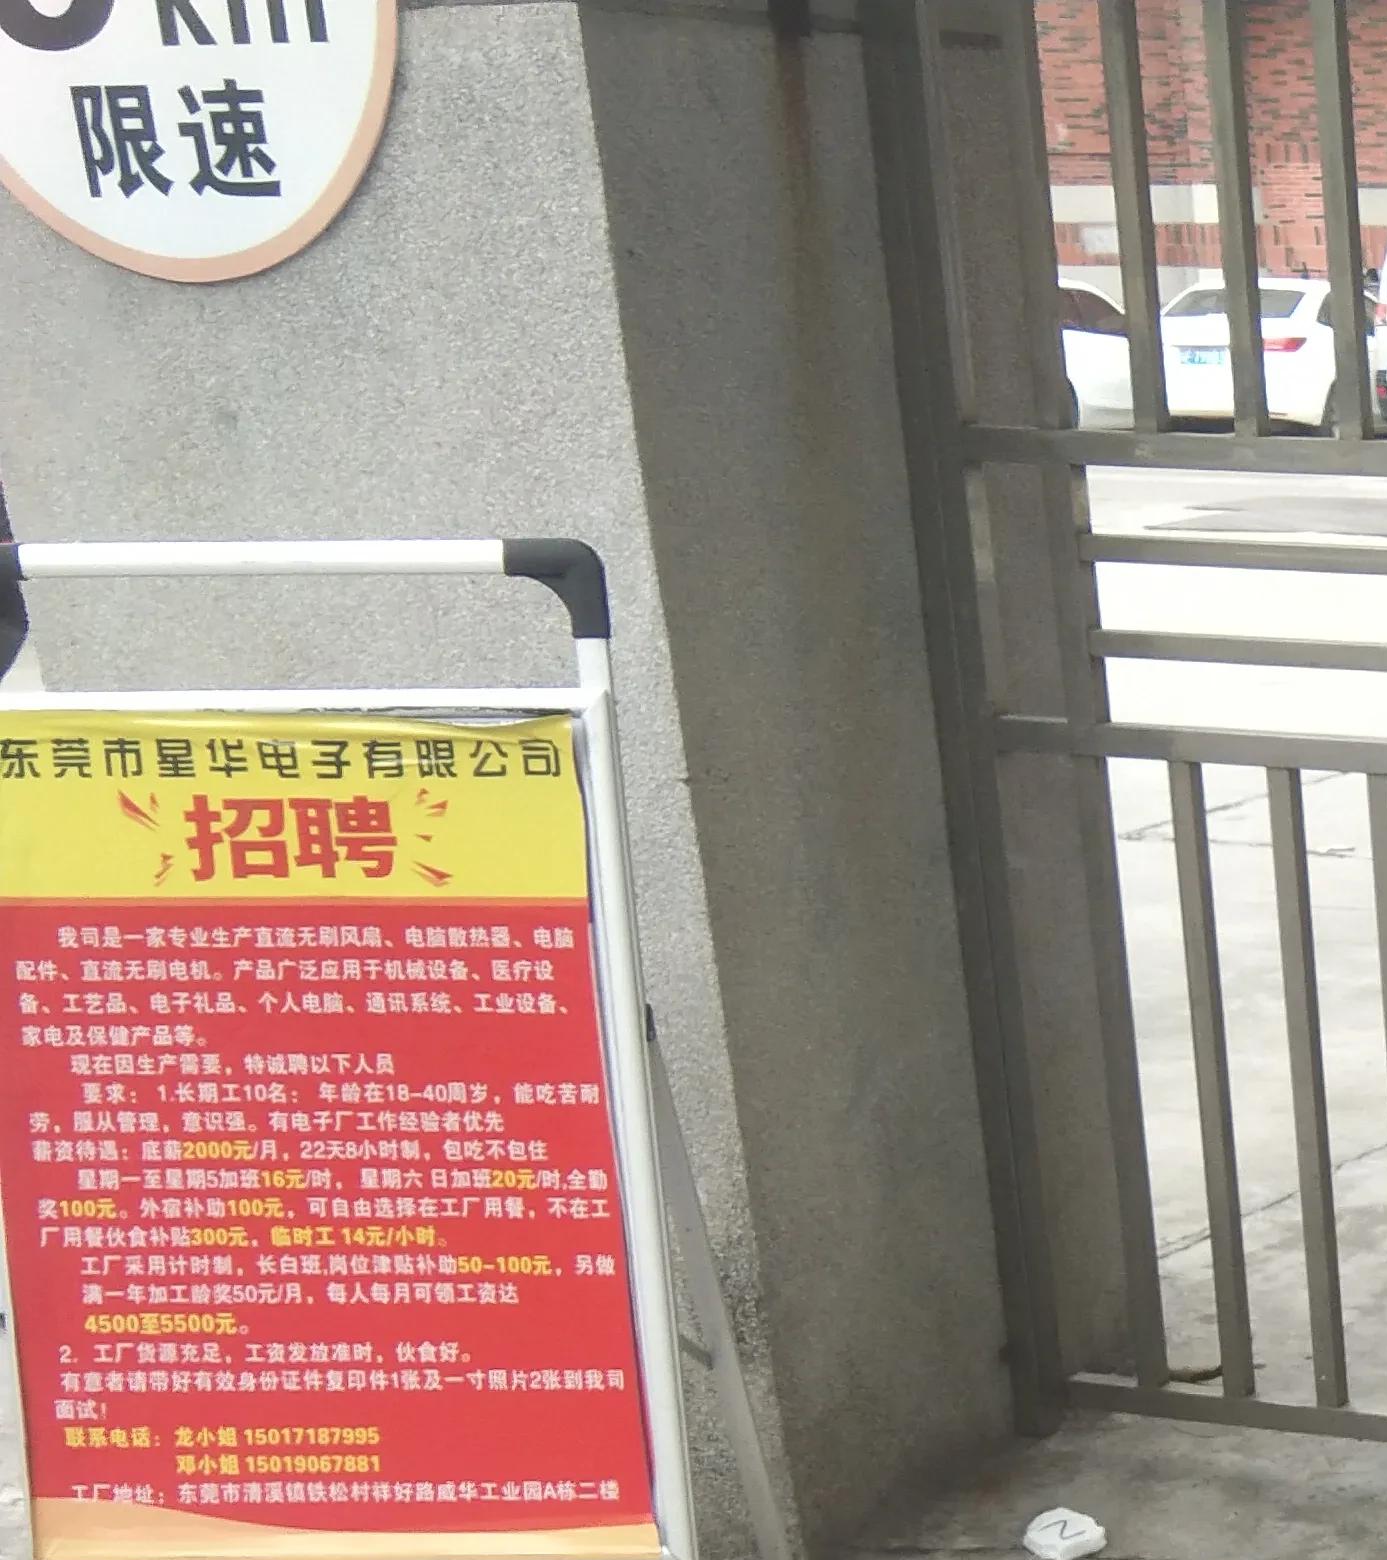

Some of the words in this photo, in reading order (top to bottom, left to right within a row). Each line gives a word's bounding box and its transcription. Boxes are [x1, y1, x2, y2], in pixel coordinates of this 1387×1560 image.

[69, 77, 283, 199] 限速
[0, 738, 563, 780] 东莞市星华电子有限公司
[184, 793, 398, 882] 招聘
[57, 925, 574, 949] 我司是一家专业生产直流无刷风扇、电脑散热器、电脑
[16, 959, 555, 983] 配件、直流无刷电机。产品广泛应用于机械设备、医疗设
[22, 1023, 208, 1048] 家电及保健产品等。
[70, 1053, 395, 1076] 现在因生产需要，特诚聘以下人员
[84, 1312, 250, 1336] 4500至5500元。
